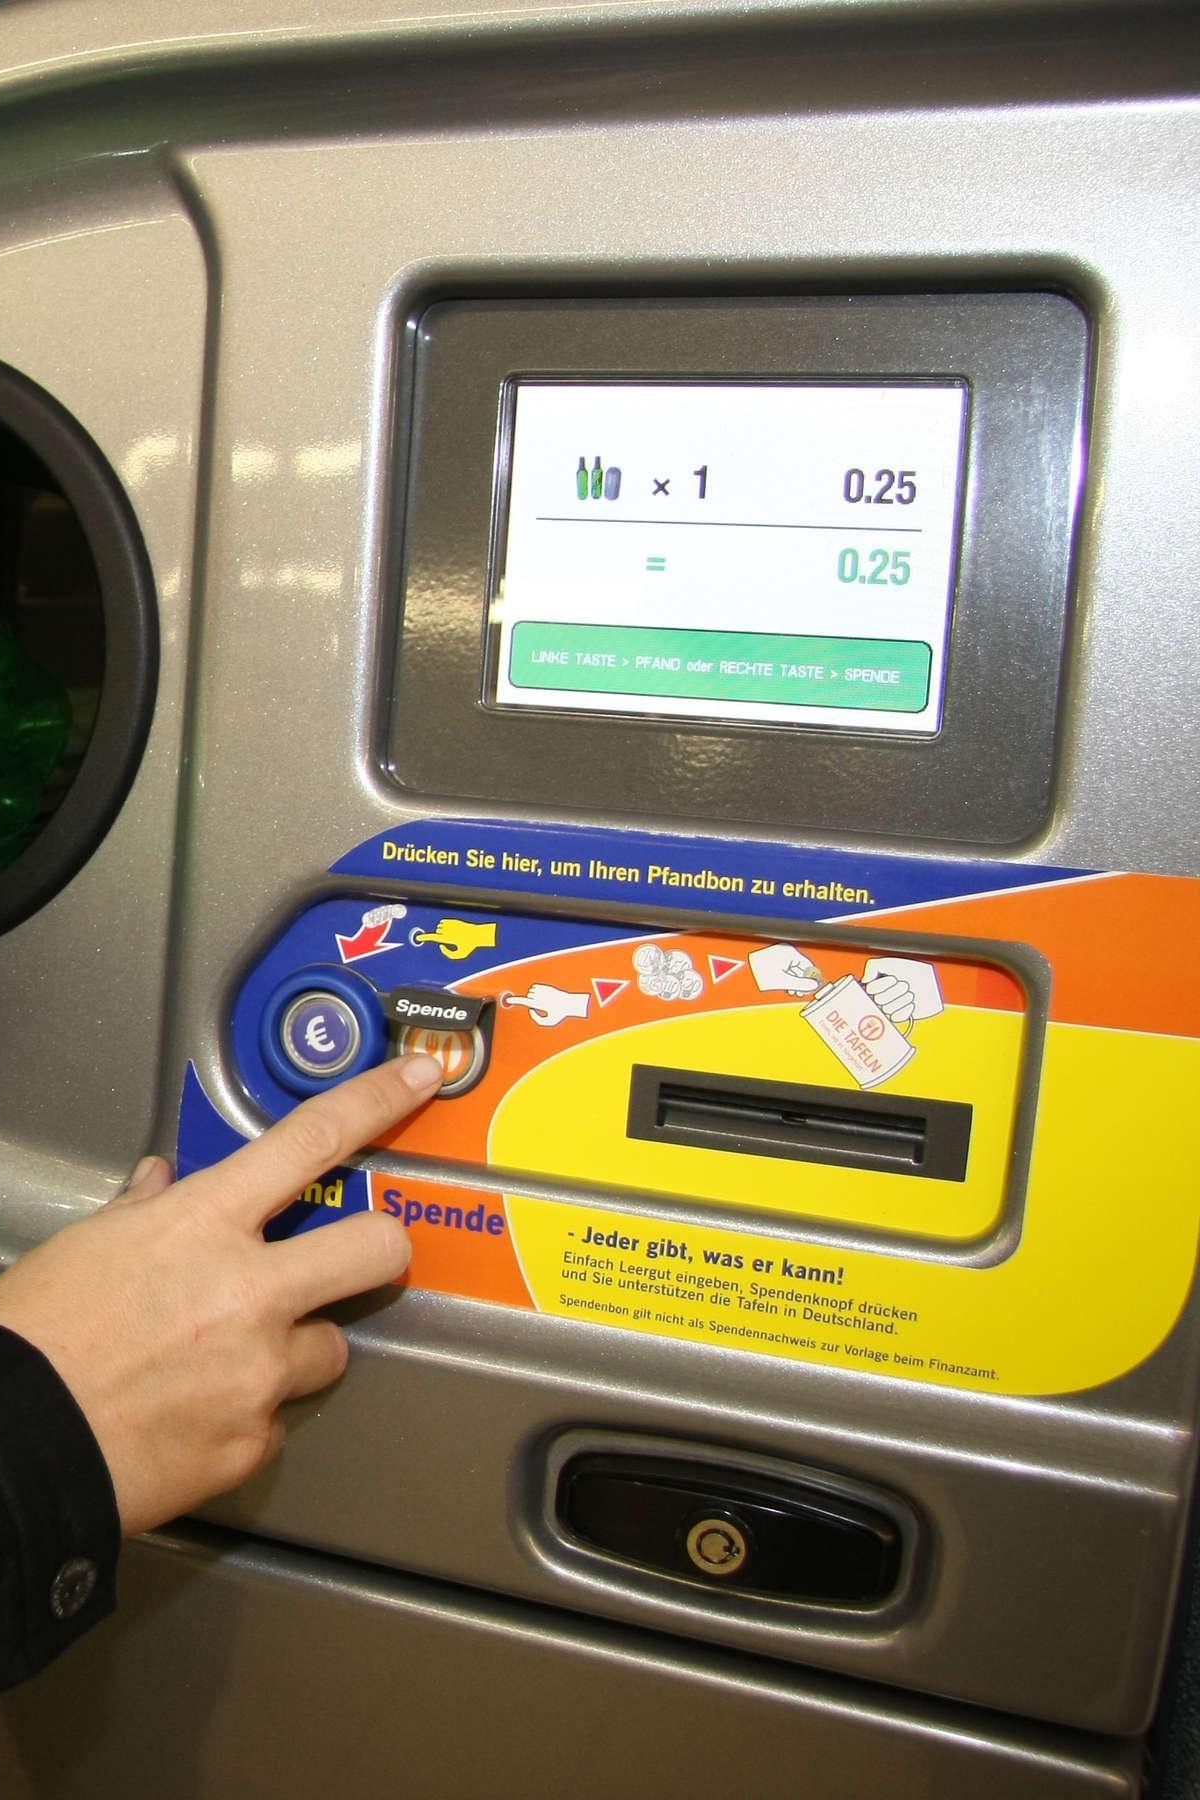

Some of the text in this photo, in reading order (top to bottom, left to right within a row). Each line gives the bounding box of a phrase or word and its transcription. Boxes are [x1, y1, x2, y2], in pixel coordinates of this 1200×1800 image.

[693, 464, 709, 500] 1
[843, 467, 917, 506] 0.25
[836, 547, 911, 586] 0.25
[531, 649, 569, 665] LINKE
[575, 652, 617, 668] TASTE
[634, 655, 681, 672] PFAND
[686, 659, 715, 673] oder
[719, 660, 774, 677] RECHTE
[780, 663, 825, 680] TASTE
[844, 667, 901, 684] SPENDE
[382, 841, 876, 905] Drücken Sie hier, um Ihren Pfandbon zu erhalten.
[304, 1015, 336, 1053] €
[395, 998, 468, 1021] Spende
[825, 1010, 849, 1034] DIE
[844, 1029, 883, 1074] TAFELN
[382, 1188, 505, 1236] Spende
[581, 1226, 640, 1252] Jeder
[645, 1238, 694, 1264] gibt,
[702, 1249, 744, 1270] was
[751, 1261, 774, 1275] er
[781, 1259, 845, 1286] kann!
[561, 1267, 899, 1336] und Sie unterstützen die Tafeln in Deutschland.
[562, 1251, 918, 1322] Einfach Leergut eingeben, Spendenknopf drücken
[559, 1294, 1000, 1381] Spendenbon gilt nicht als Spendennachweis zur Vorlage beim Finanzamt.
